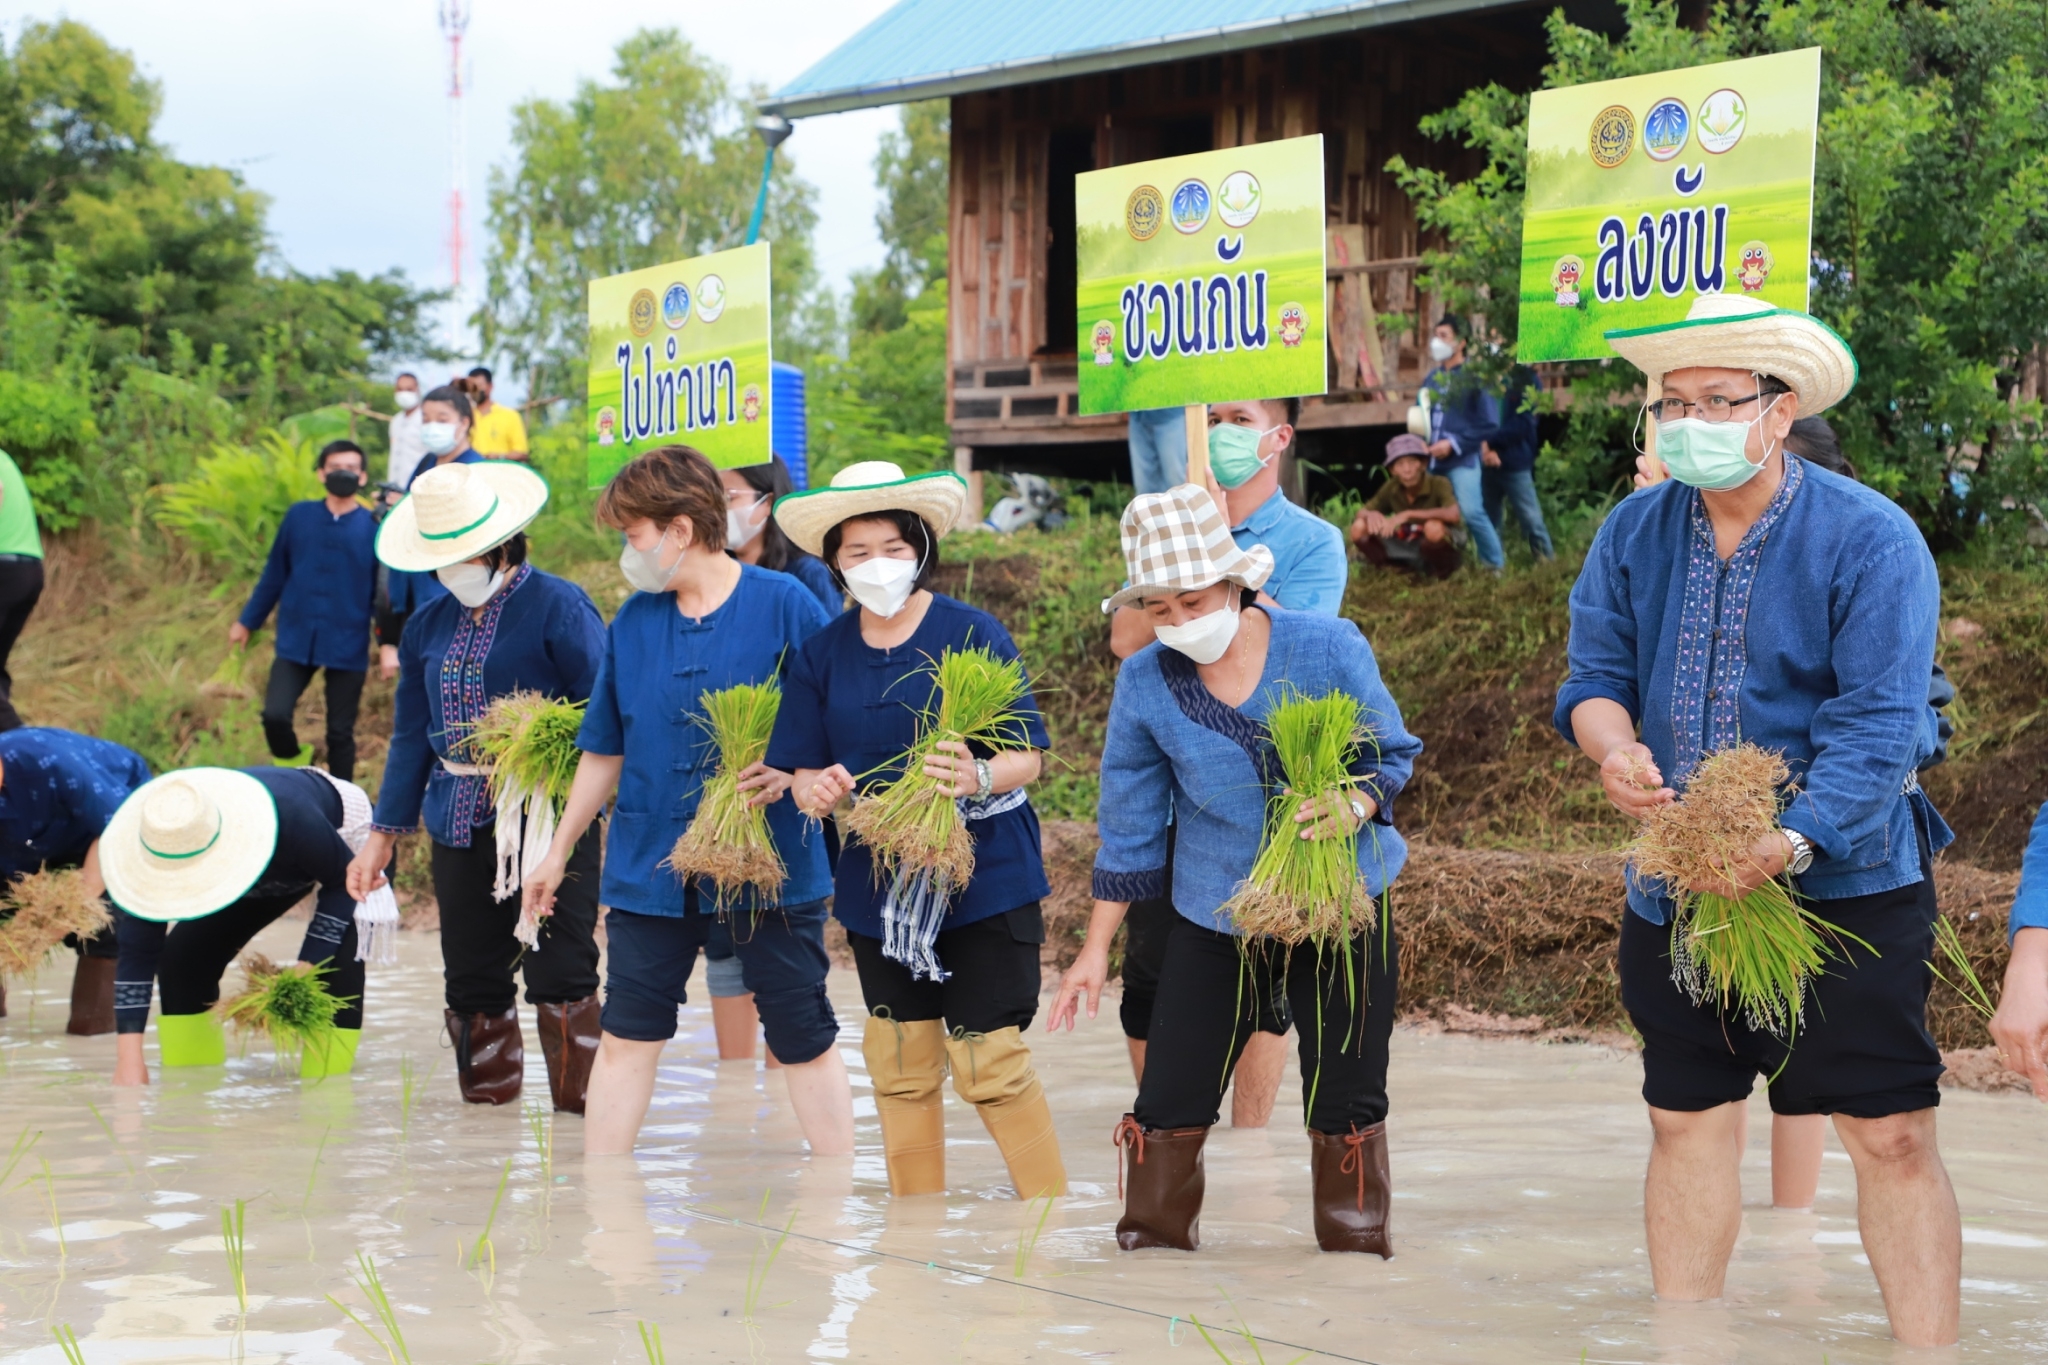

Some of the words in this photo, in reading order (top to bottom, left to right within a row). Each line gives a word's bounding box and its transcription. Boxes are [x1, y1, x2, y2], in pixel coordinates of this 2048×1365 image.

[1597, 165, 1727, 299] ลงขัน
[1122, 235, 1267, 358] ชวนกัน
[618, 337, 735, 439] ไปทำนา
